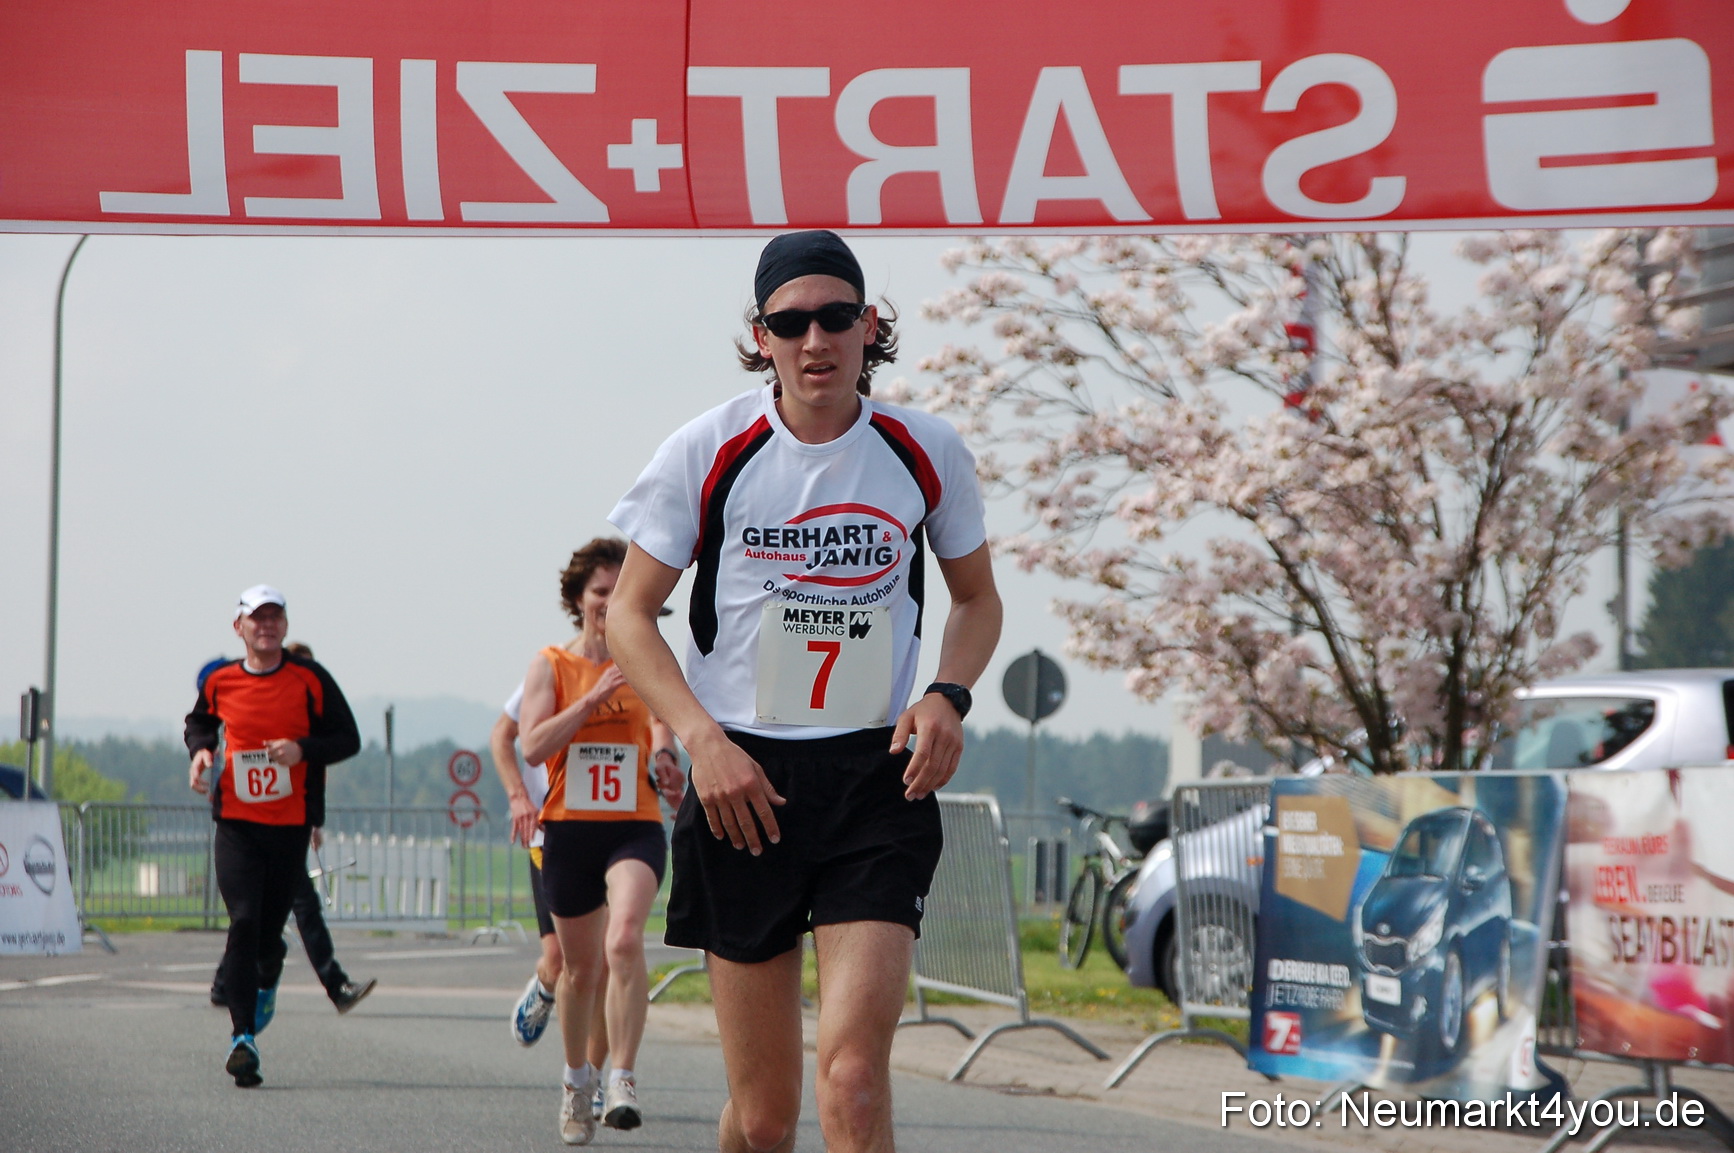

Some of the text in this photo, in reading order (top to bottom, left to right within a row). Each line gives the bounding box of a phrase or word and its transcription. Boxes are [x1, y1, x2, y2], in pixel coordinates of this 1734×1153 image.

[742, 525, 892, 548] GERHART &
[745, 548, 806, 562] Autohaus
[850, 574, 900, 606] Autohaus
[783, 608, 845, 625] MEYER
[783, 623, 845, 636] WERBUNG
[807, 640, 841, 709] 7
[247, 767, 280, 797] 62
[588, 764, 622, 803] 15
